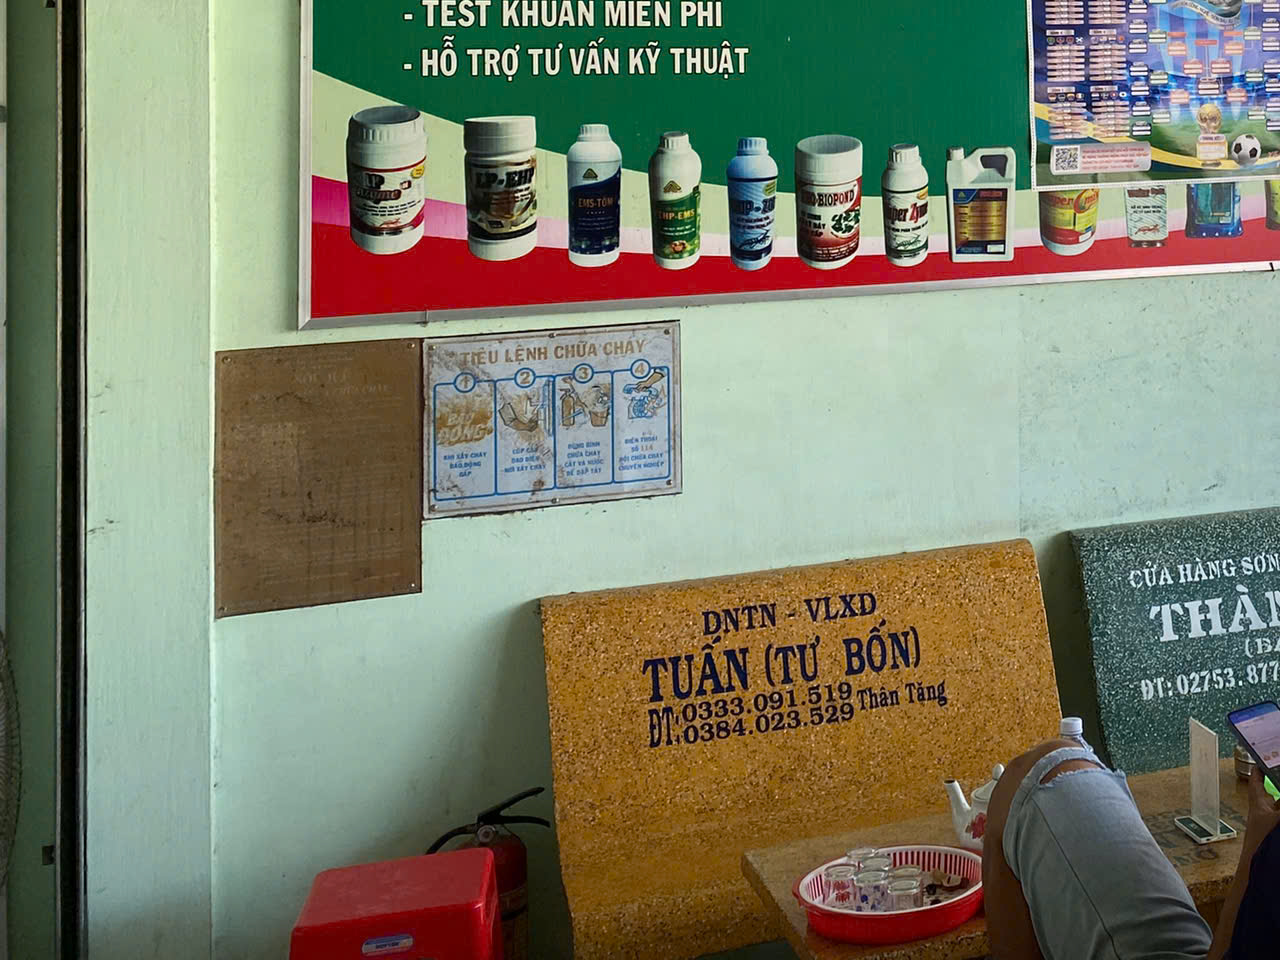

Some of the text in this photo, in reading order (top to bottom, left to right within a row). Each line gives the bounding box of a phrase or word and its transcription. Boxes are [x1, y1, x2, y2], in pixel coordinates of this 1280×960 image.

[421, 0, 492, 27] TEST
[421, 35, 749, 81] HỖ TRỢ TƯ VẤN KỸ THUẬT
[505, 344, 548, 365] LỆNH
[554, 340, 597, 359] CHỮA
[634, 363, 645, 376] 4
[519, 372, 530, 385] 2
[578, 367, 589, 380] 3
[1128, 560, 1174, 589] CỬA
[1178, 556, 1236, 583] HÀNG
[1241, 551, 1280, 576] SƠN
[702, 592, 878, 636] DNTN VLXD
[643, 618, 921, 703] TUẤN (TƯ BỐN)
[1140, 675, 1173, 701] ĐT:
[1246, 660, 1280, 685] 877
[683, 681, 851, 723] 0333.091.519
[683, 680, 948, 745] 0384.023.529 Thân Tăng
